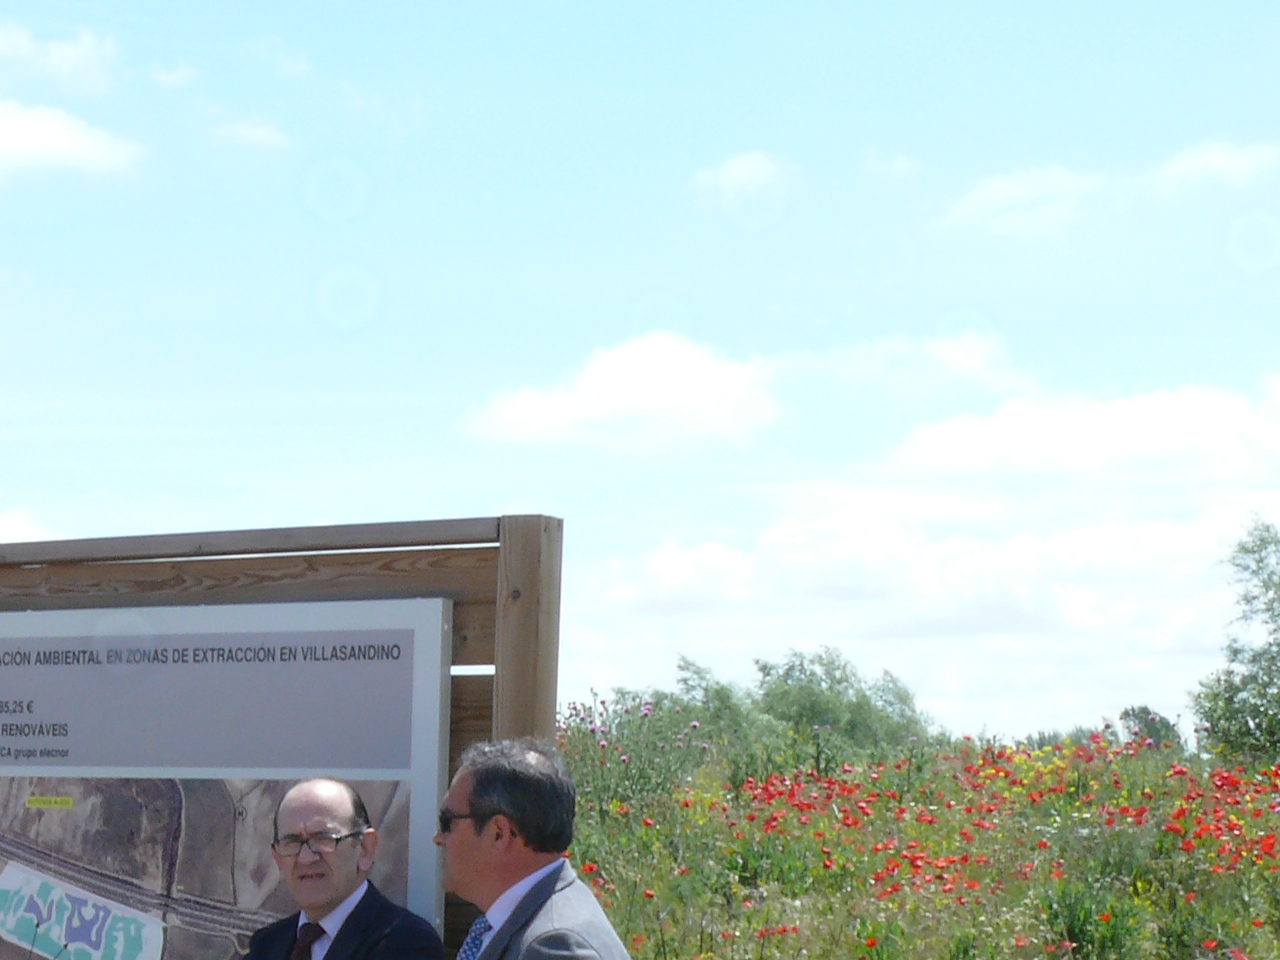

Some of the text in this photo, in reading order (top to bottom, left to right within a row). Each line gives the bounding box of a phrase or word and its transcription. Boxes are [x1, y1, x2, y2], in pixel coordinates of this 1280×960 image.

[34, 649, 102, 666] AMBIENTAL
[106, 649, 122, 665] EN
[125, 648, 168, 664] ZONAS
[172, 647, 189, 663] DE
[192, 643, 275, 663] EXTRACCIÓN
[280, 645, 297, 662] EN
[301, 644, 401, 662] VILLASANDINO
[26, 700, 34, 713] €
[1, 720, 69, 737] RENOVÁVEIS
[13, 748, 37, 761] grupo
[39, 747, 69, 758] elecnor
